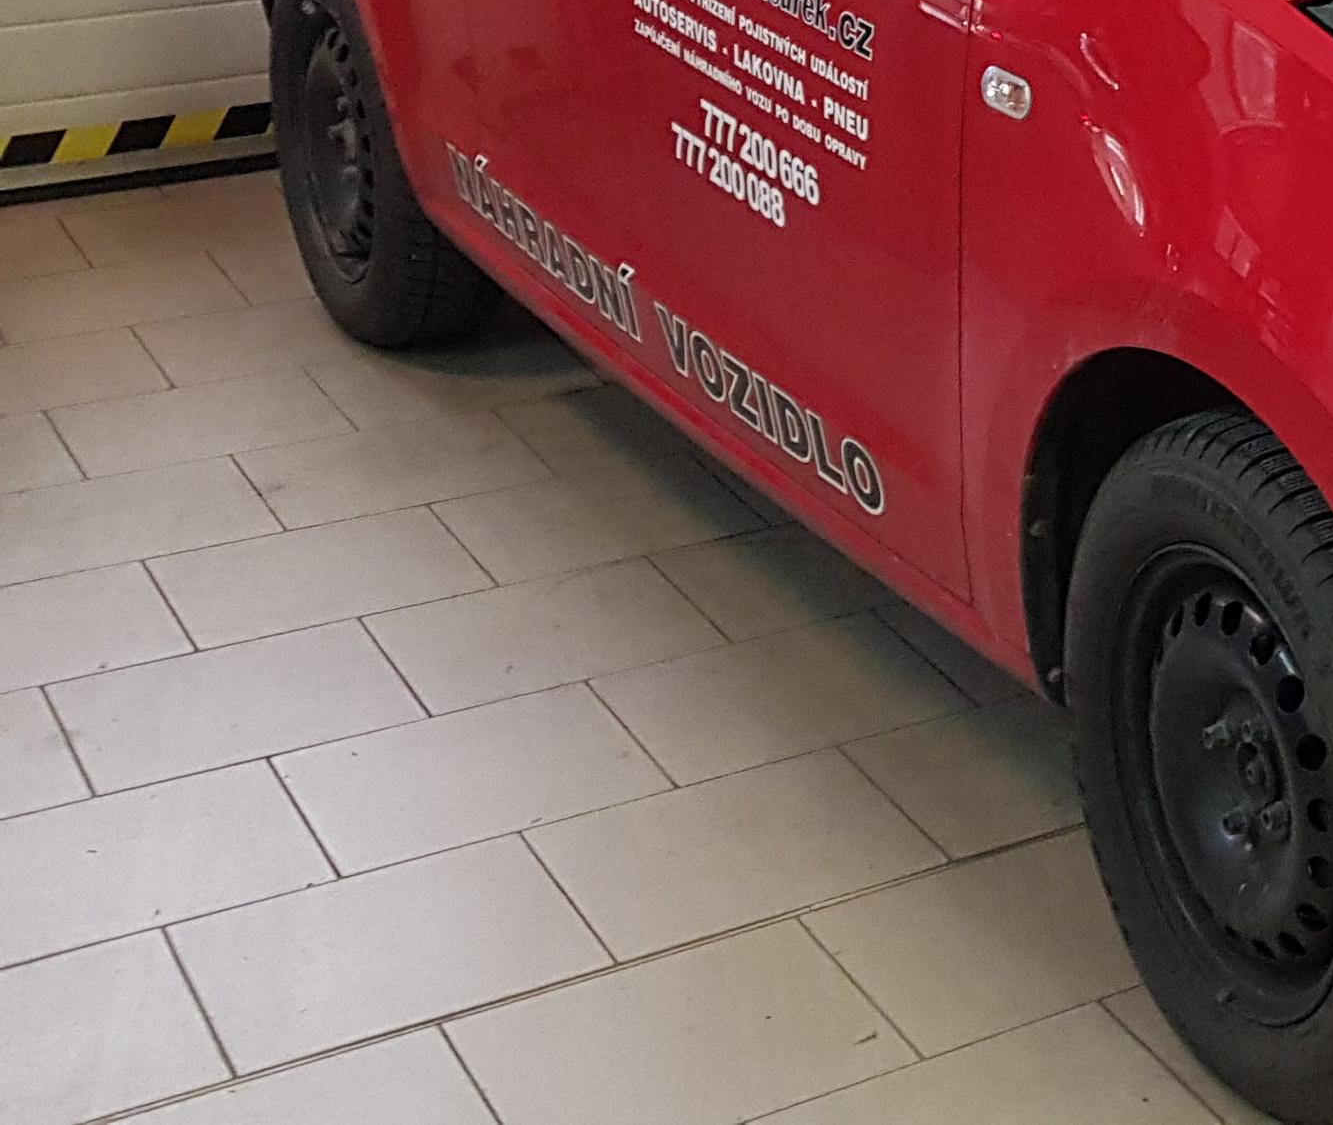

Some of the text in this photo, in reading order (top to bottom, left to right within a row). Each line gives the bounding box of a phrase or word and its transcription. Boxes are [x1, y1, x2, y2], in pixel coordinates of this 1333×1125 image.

[733, 43, 806, 105] LAKOVNA
[823, 95, 869, 141] PNEU
[738, 14, 806, 67] POJISTNÝCH
[810, 54, 868, 101] UDÁLOSTÍ
[671, 121, 786, 227] 777 200 088
[699, 98, 820, 206] 777 200 666
[745, 86, 773, 114] VOZU
[774, 103, 790, 124] PO
[792, 114, 821, 144] DOBU
[824, 134, 867, 171] OPRAVY
[445, 141, 886, 515] NÁHRADNÍ VOZIDLO
